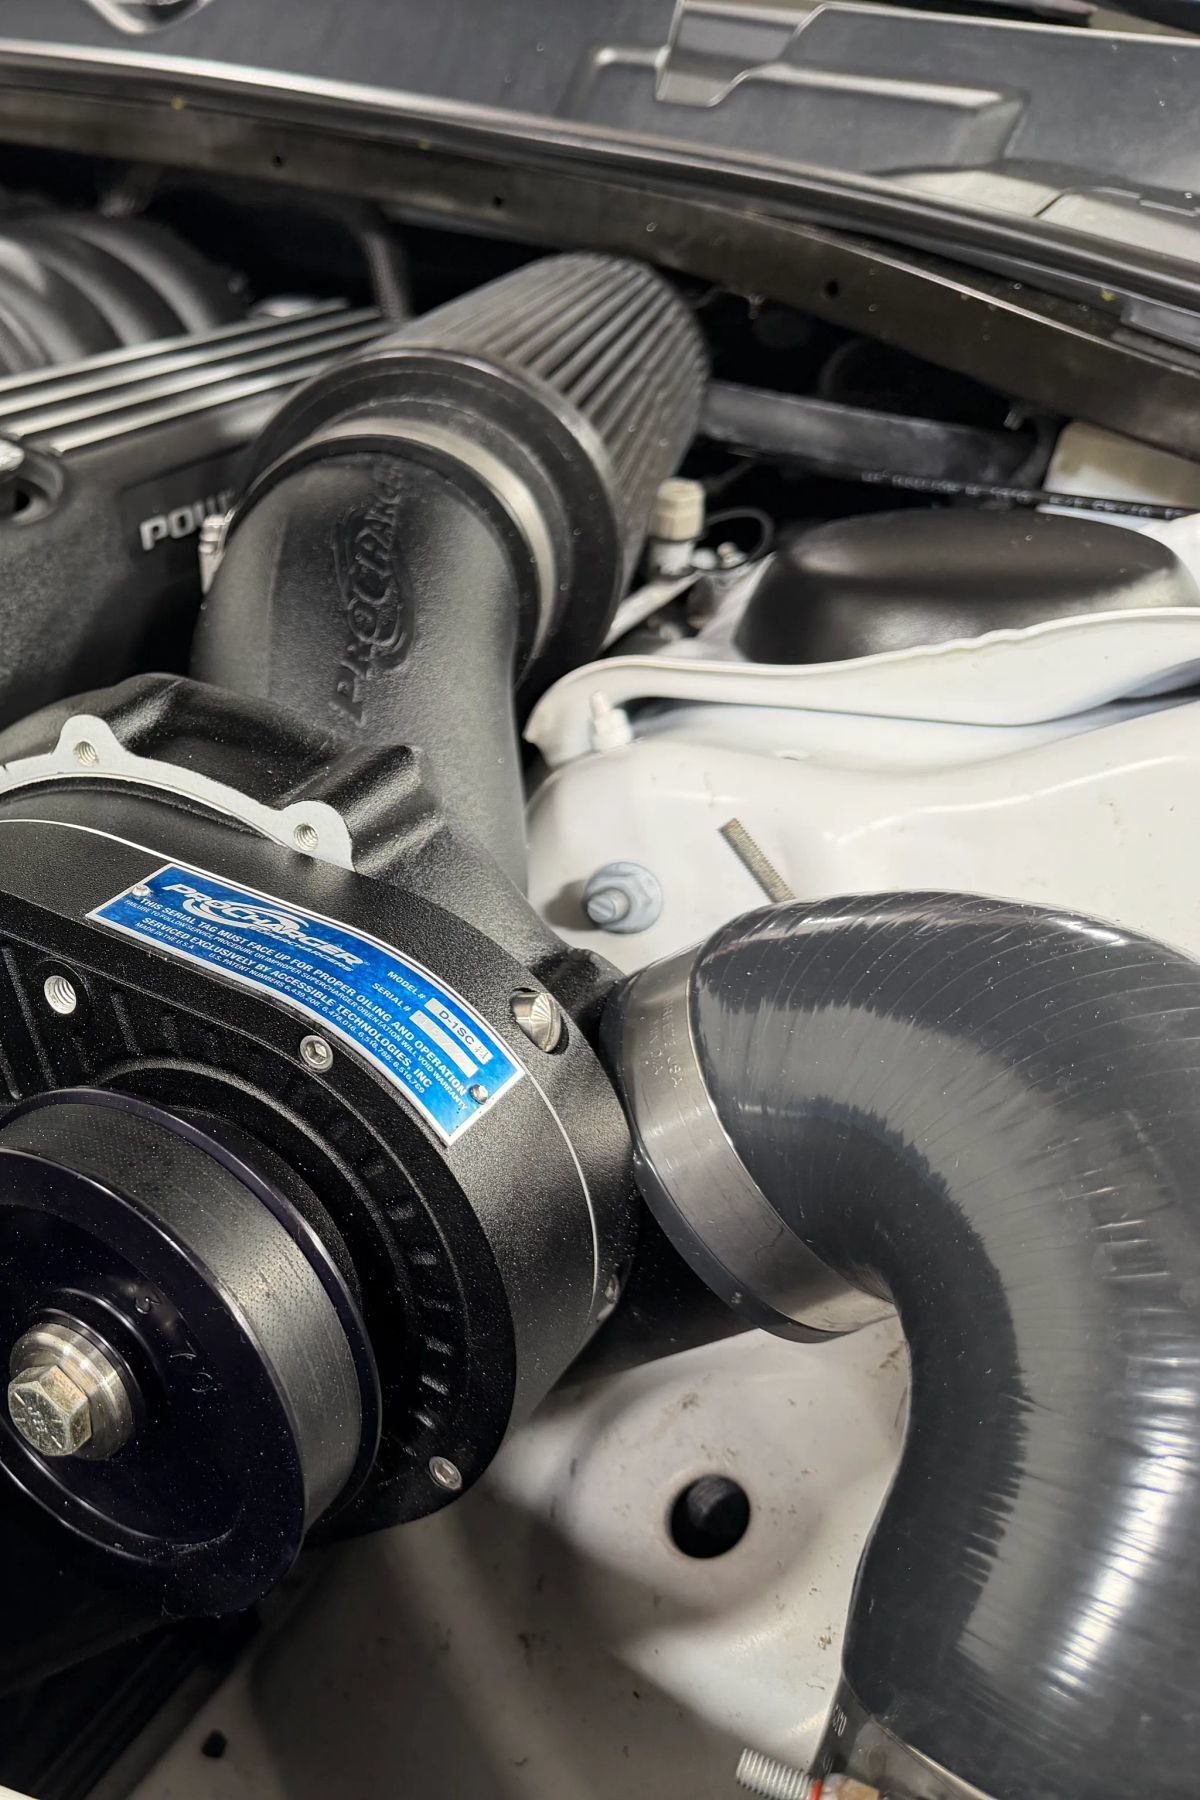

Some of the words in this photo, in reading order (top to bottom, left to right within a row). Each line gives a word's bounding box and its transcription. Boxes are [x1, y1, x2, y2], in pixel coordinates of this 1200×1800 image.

[135, 922, 155, 935] MADE
[163, 933, 177, 941] THE
[222, 959, 250, 974] PATENT
[248, 970, 285, 988] NUMBERS
[387, 971, 418, 995] MODEL
[124, 900, 152, 913] FAILURE
[160, 914, 187, 927] FOLLOW
[186, 924, 215, 939] SERVICE
[213, 936, 254, 955] PROCEDURE
[254, 952, 265, 960] OR
[264, 956, 302, 975] IMPROPER
[301, 972, 358, 1007] SUPERCHARGER
[357, 1004, 402, 1042] ORIENTATION
[401, 1039, 417, 1057] WILL
[418, 1055, 434, 1072] VOID
[433, 1070, 468, 1110] WARRANTY
[140, 898, 164, 910] THIS
[162, 907, 196, 925] SERIAL
[198, 921, 218, 933] TAG
[217, 930, 247, 944] MUST
[247, 941, 275, 956] FACE
[275, 953, 291, 961] UP
[290, 959, 313, 972] FOR
[313, 969, 356, 996] PROPER
[356, 994, 392, 1022] OILING
[391, 1021, 414, 1041] AND
[414, 1040, 467, 1097] OPERATION
[142, 917, 191, 940] SERVICED
[190, 936, 256, 966] EXCLUSIVELY
[255, 963, 272, 972] BY
[270, 970, 336, 1006] ACCESSIBLE
[335, 1003, 412, 1070] TECHNOLOGIES,
[413, 1068, 433, 1088] INC
[371, 983, 404, 1007] SERIAL
[438, 1010, 475, 1045] D-1SC
